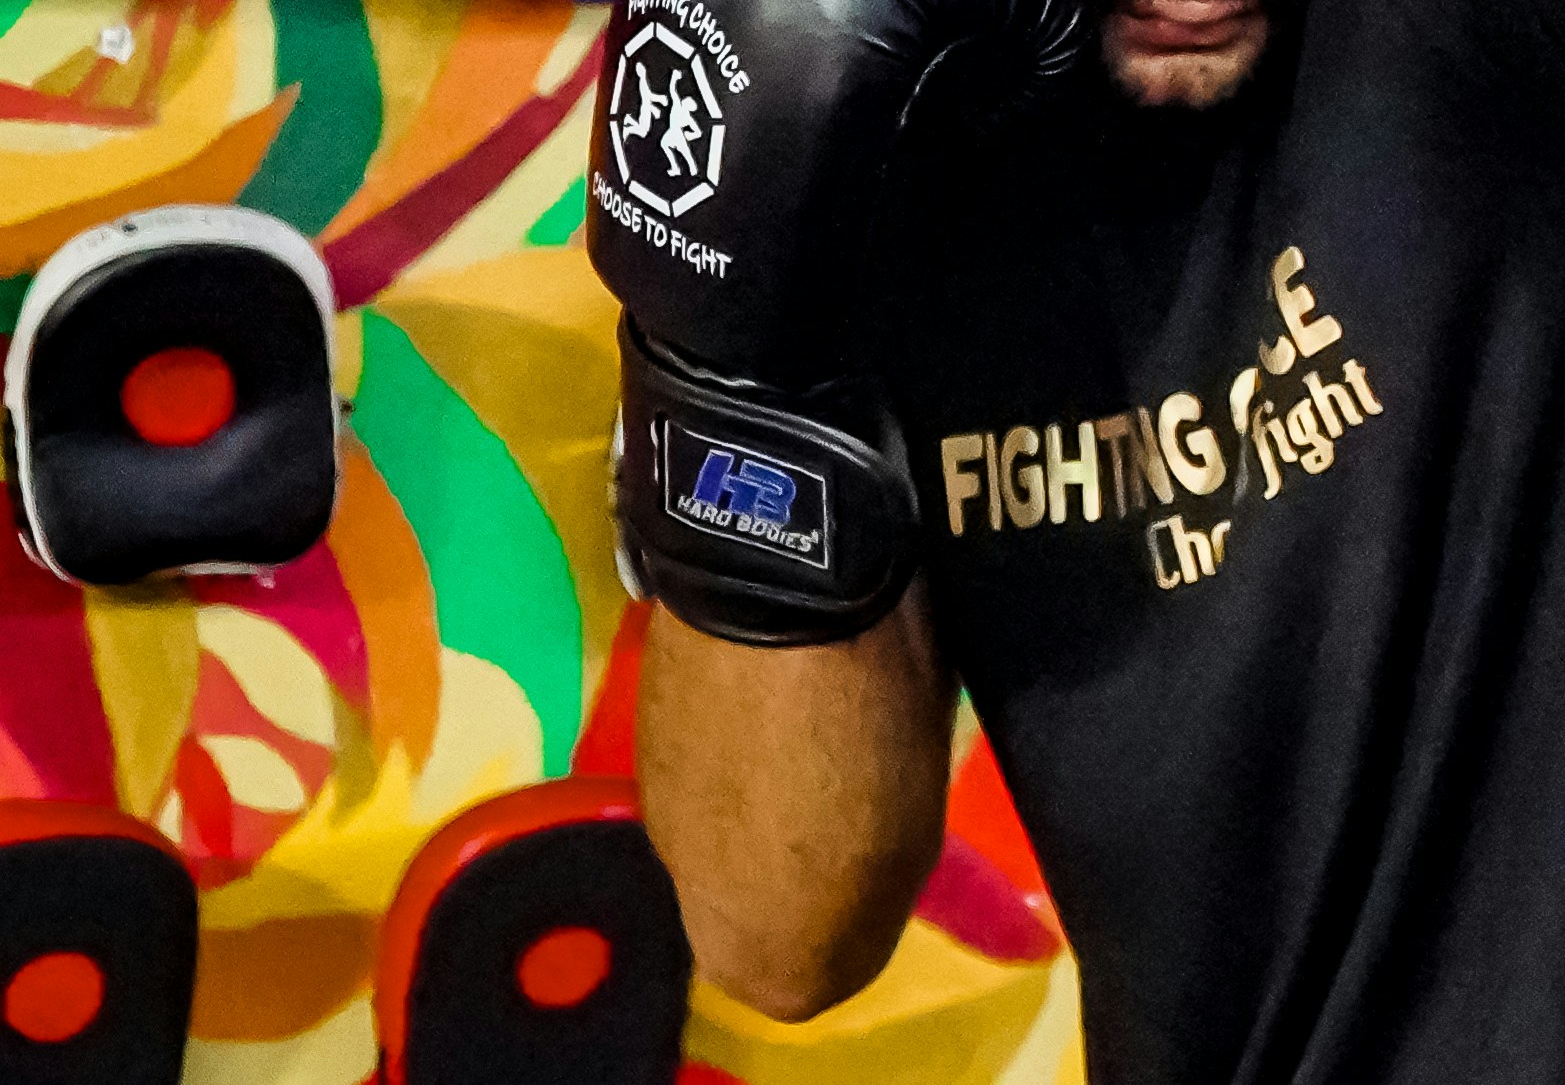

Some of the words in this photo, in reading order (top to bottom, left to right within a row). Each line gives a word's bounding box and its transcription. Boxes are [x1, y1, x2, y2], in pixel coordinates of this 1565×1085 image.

[689, 3, 750, 94] CHOICE
[592, 171, 642, 233] CHOOSE
[643, 215, 667, 249] TO
[670, 230, 733, 279] FIGHT
[1250, 358, 1384, 501] fight
